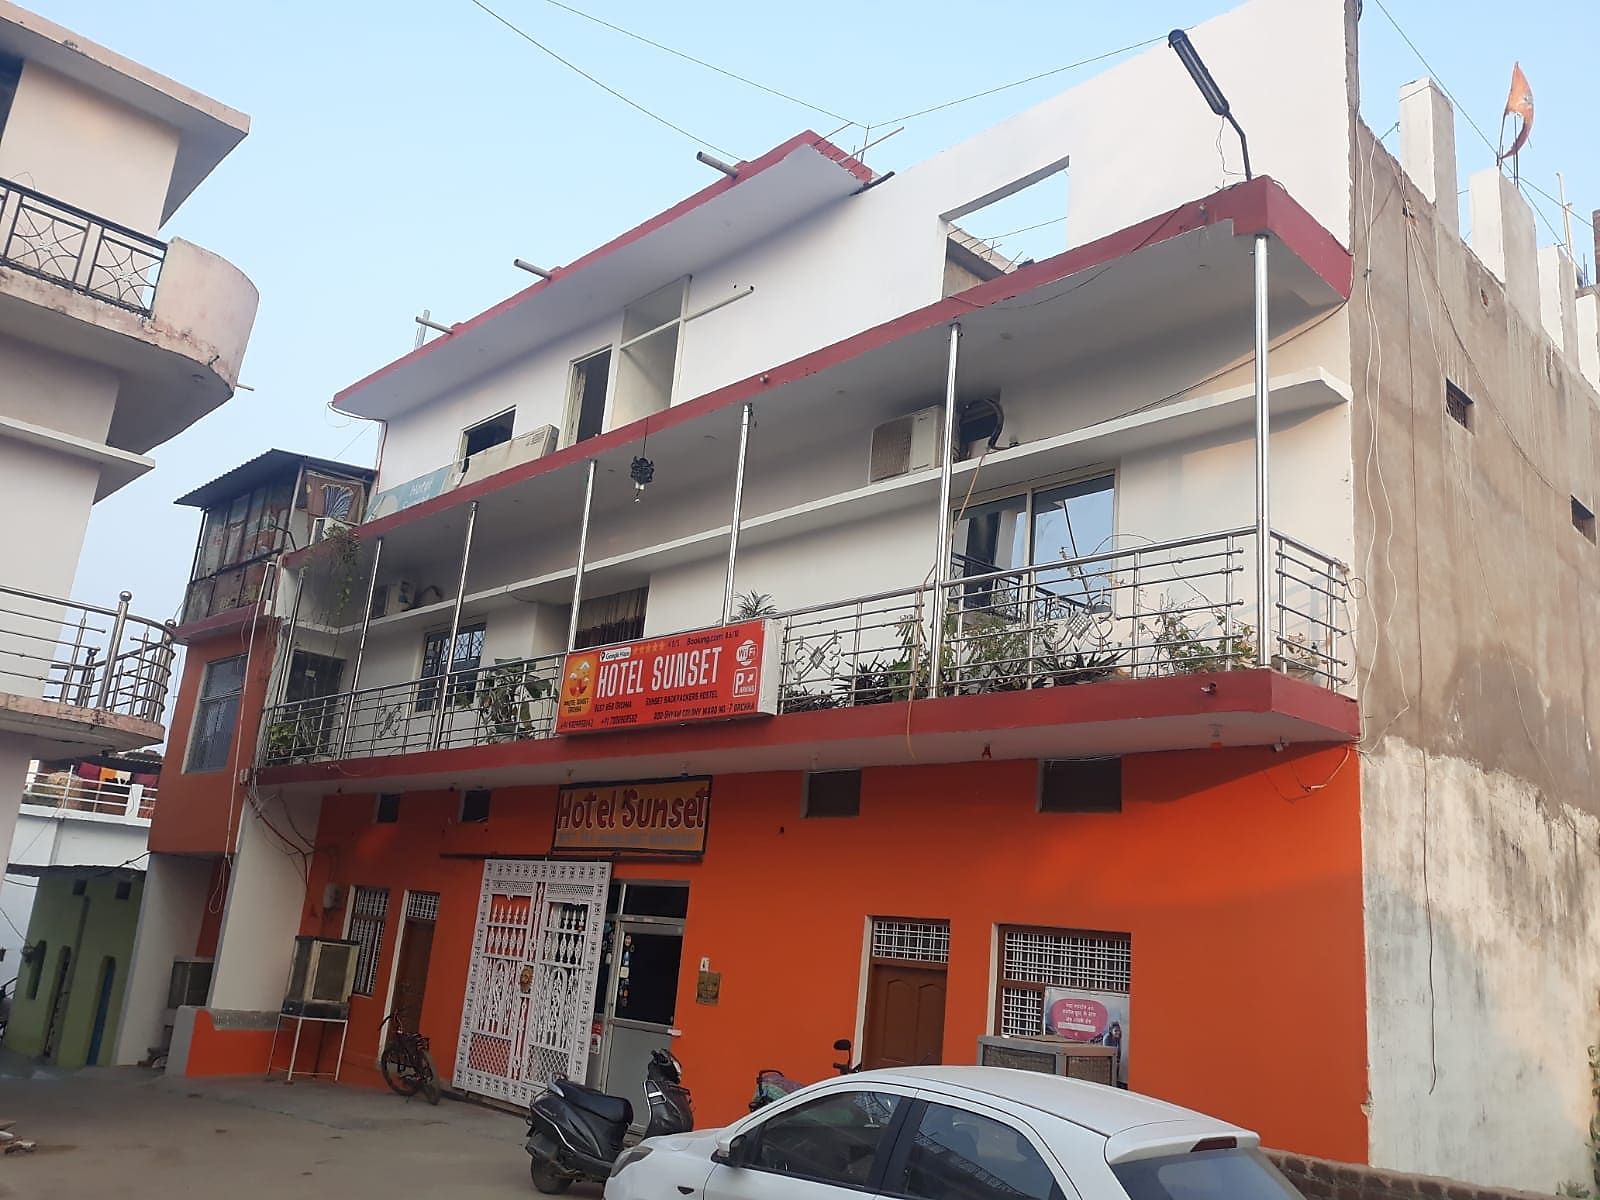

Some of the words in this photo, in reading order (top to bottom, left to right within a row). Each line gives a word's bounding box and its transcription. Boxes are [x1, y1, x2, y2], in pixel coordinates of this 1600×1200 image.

[596, 659, 644, 699] HOTEL
[651, 646, 723, 692] SUNSET
[557, 790, 617, 829] Hotel
[621, 787, 711, 829] Sunset
